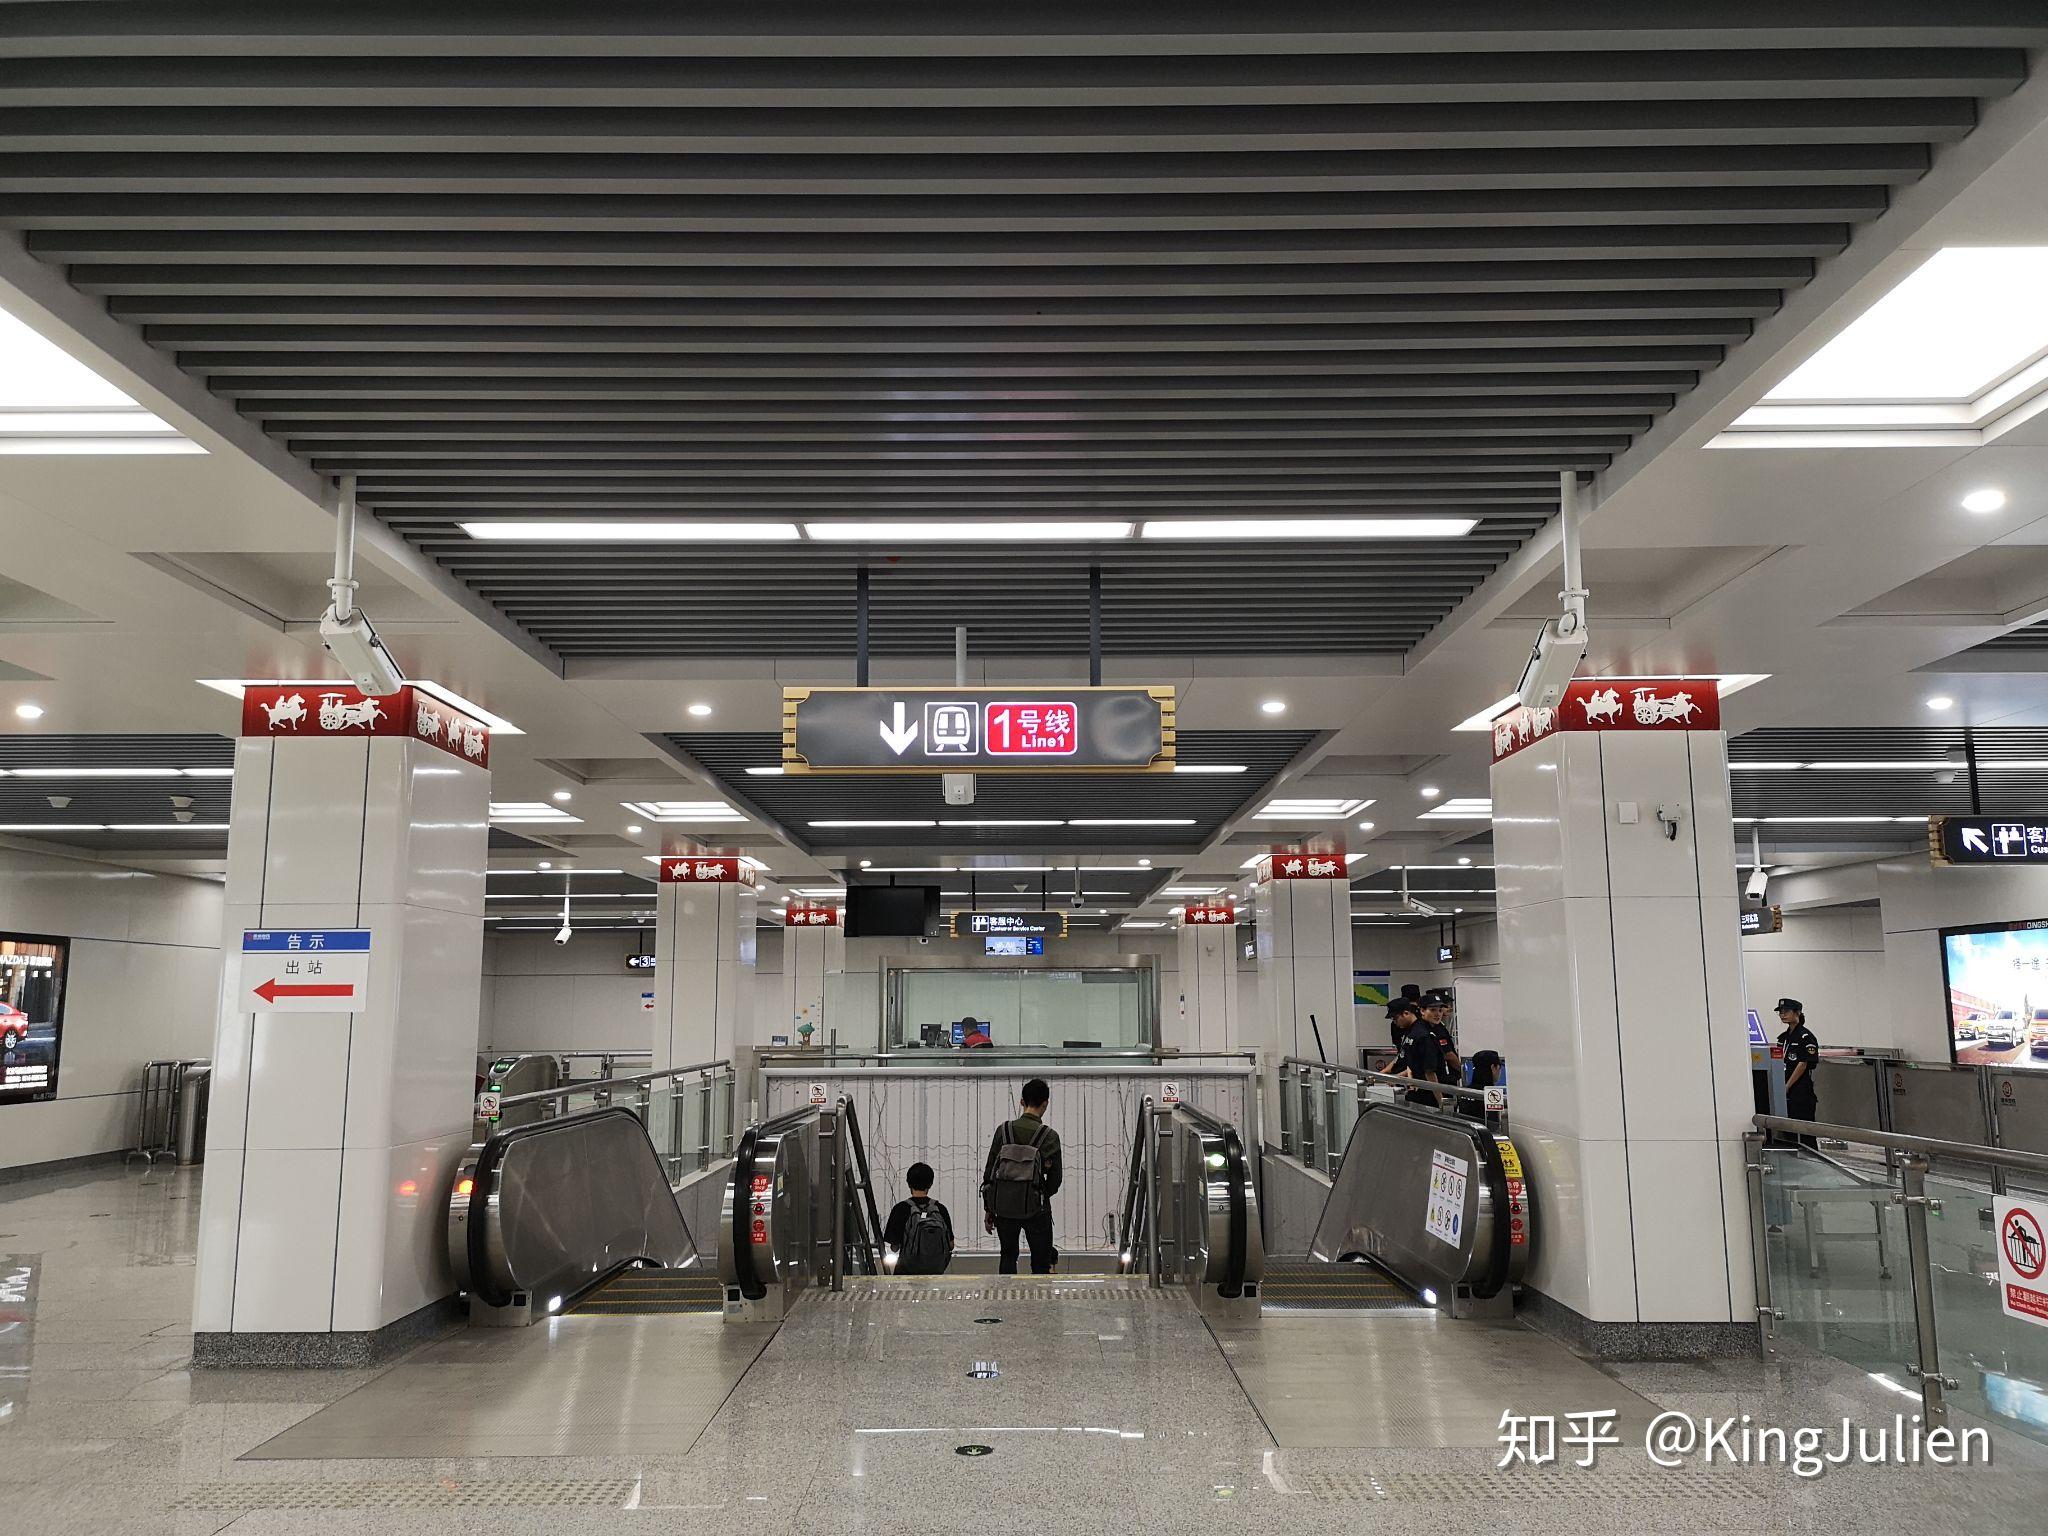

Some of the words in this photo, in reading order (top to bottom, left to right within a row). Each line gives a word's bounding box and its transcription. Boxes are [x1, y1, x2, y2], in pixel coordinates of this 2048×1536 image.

[1021, 734, 1065, 748] Line1
[2026, 826, 2048, 844] 客
[989, 916, 1024, 926] 客服中心
[287, 933, 325, 950] 告示
[285, 959, 323, 975] 出站
